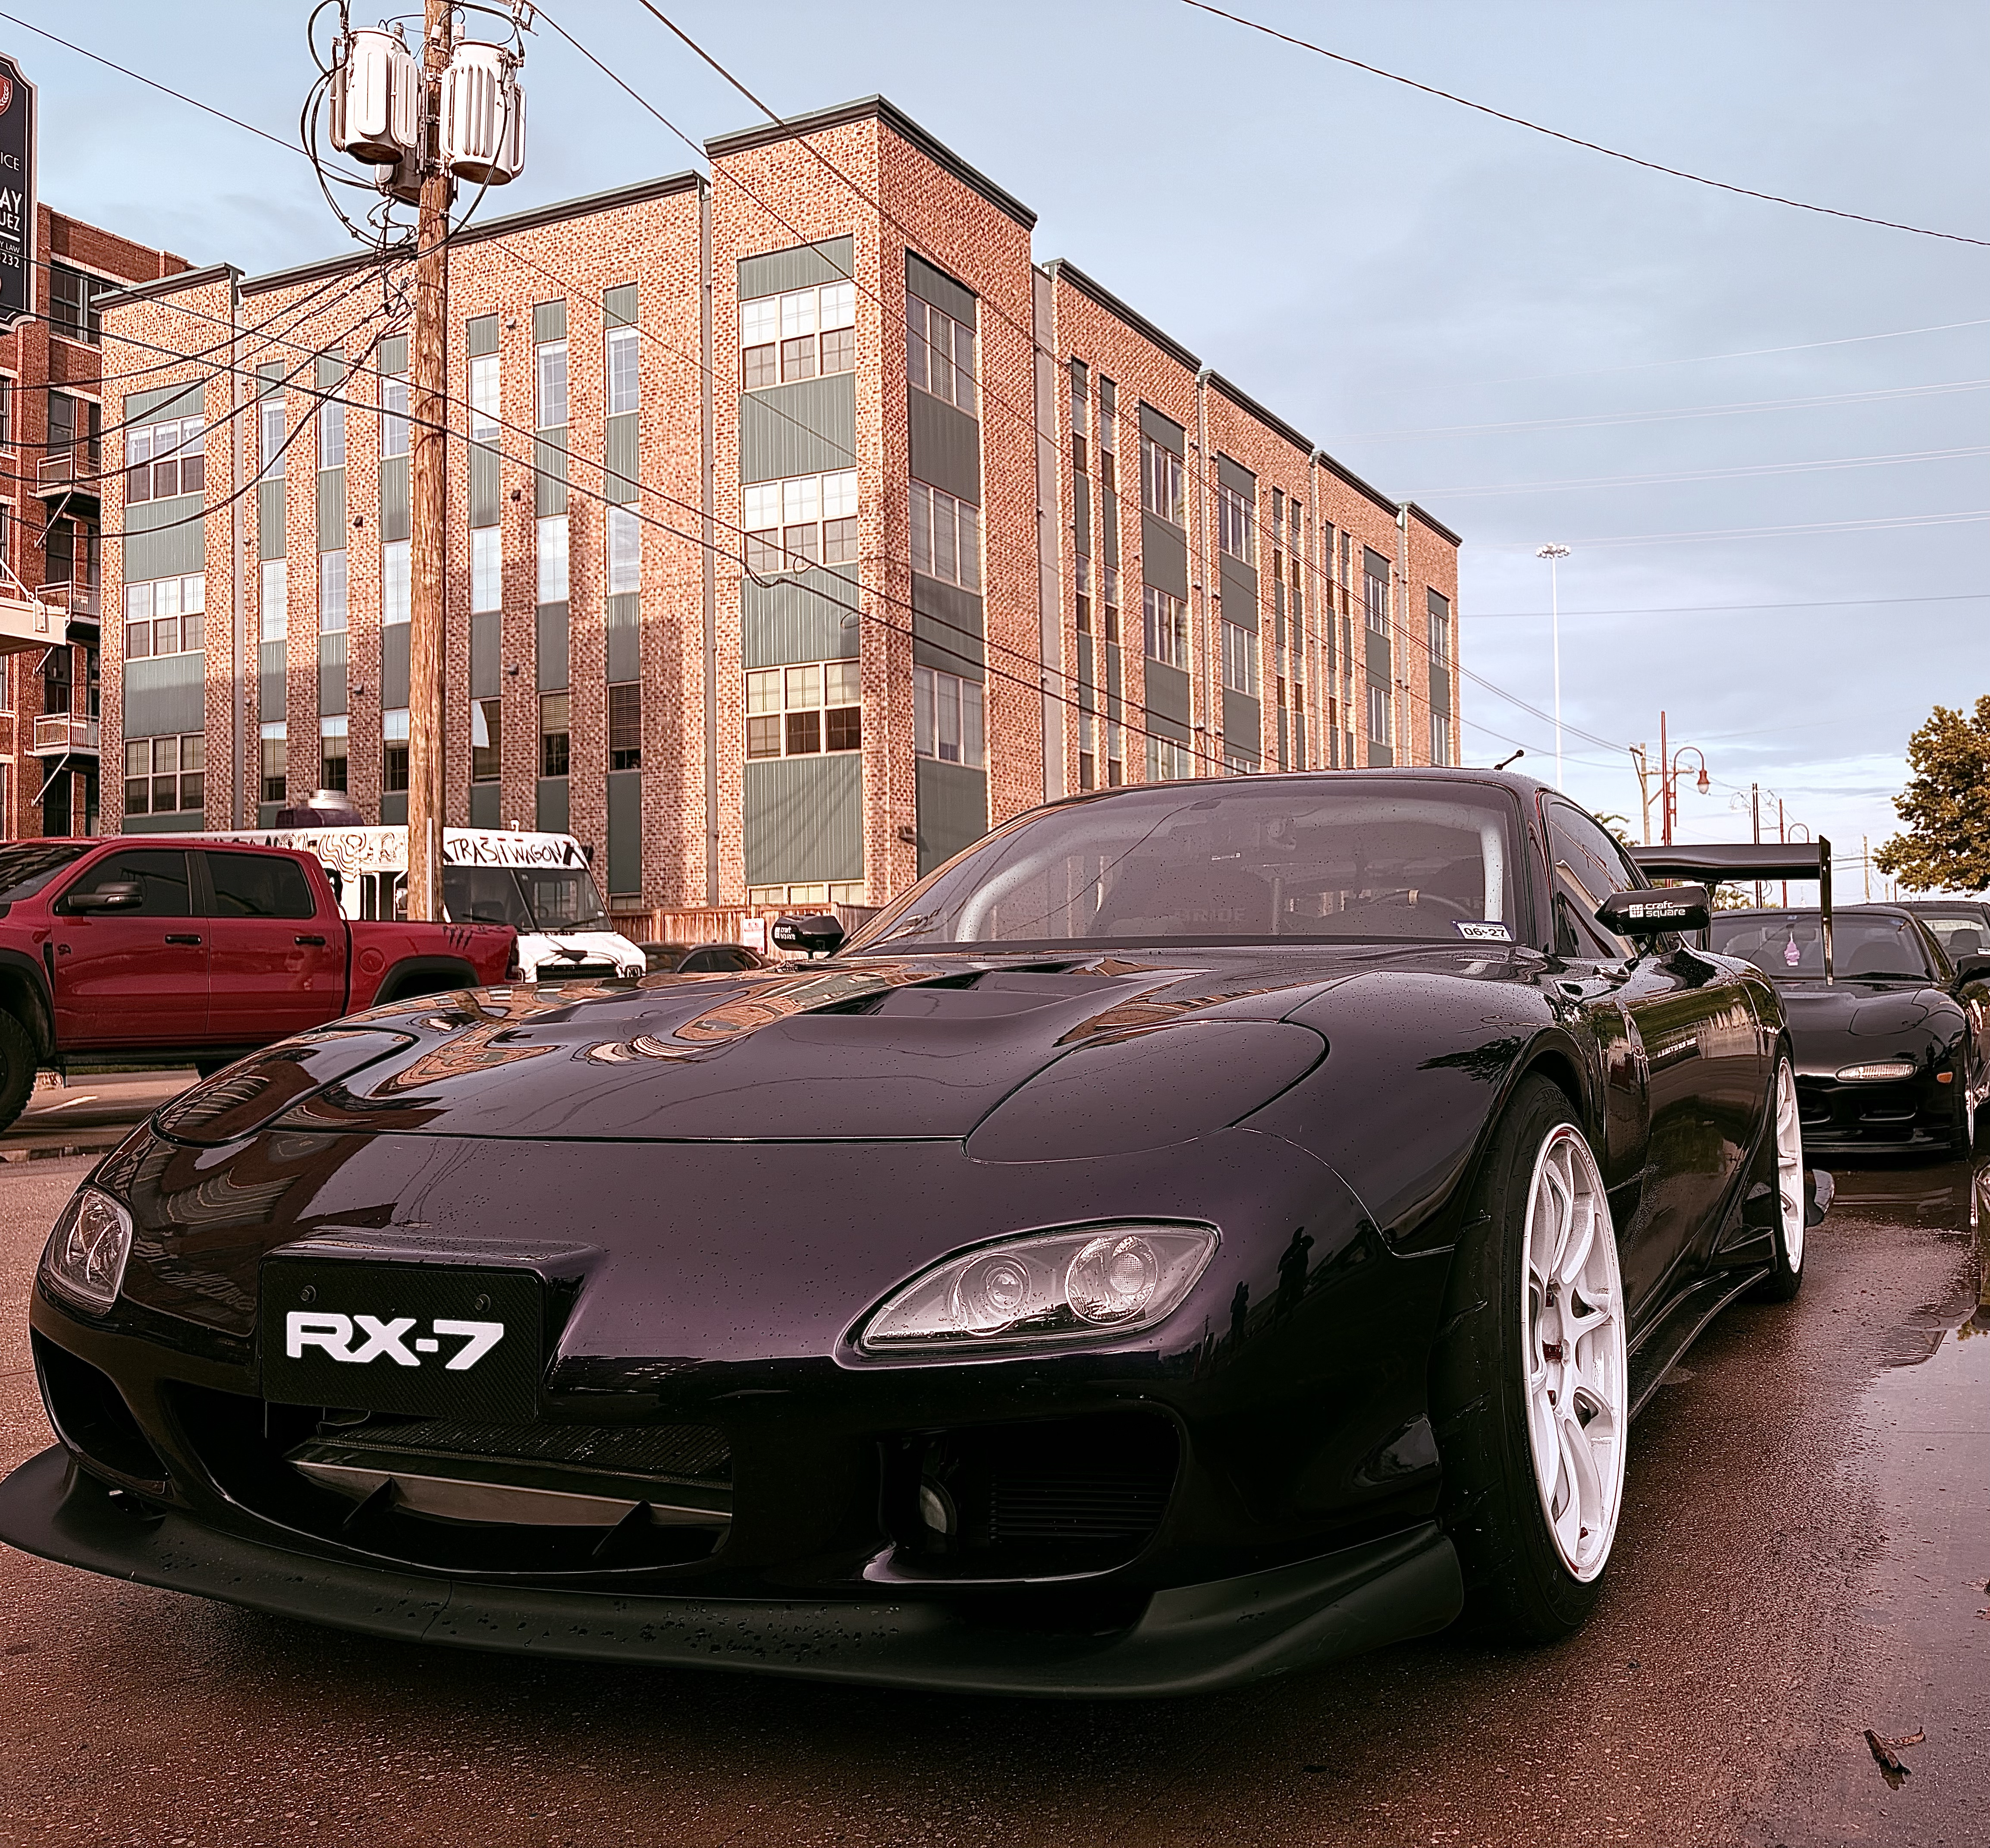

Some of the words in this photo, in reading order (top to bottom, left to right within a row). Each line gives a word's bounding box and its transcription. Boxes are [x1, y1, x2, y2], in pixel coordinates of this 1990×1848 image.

[6, 242, 20, 253] LAW
[0, 252, 19, 268] 232
[507, 840, 562, 864] WAGON
[1645, 901, 1673, 909] craft
[1646, 909, 1685, 918] square
[286, 1311, 504, 1370] RX-7
